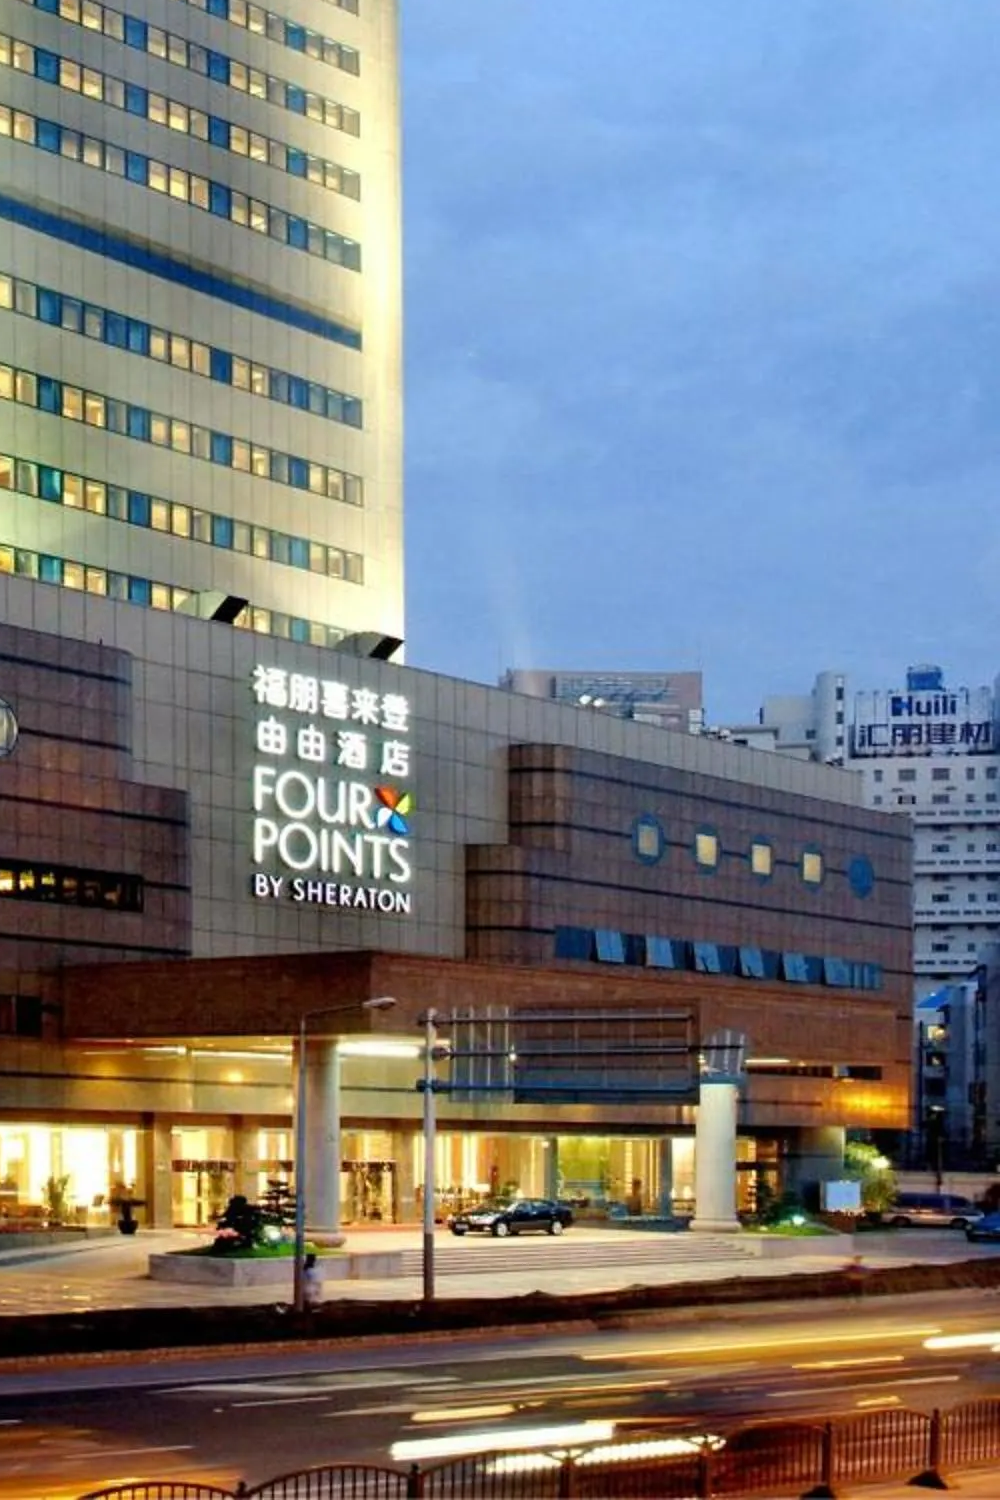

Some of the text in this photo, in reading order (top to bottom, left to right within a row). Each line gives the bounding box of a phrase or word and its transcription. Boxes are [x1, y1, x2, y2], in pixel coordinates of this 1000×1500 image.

[253, 664, 410, 732] 福朋喜来登
[890, 693, 957, 717] Huili
[256, 715, 411, 778] 由由酒店
[253, 764, 376, 830] FOUR
[253, 817, 412, 883] POINTS
[254, 873, 412, 914] BY SHERATON
